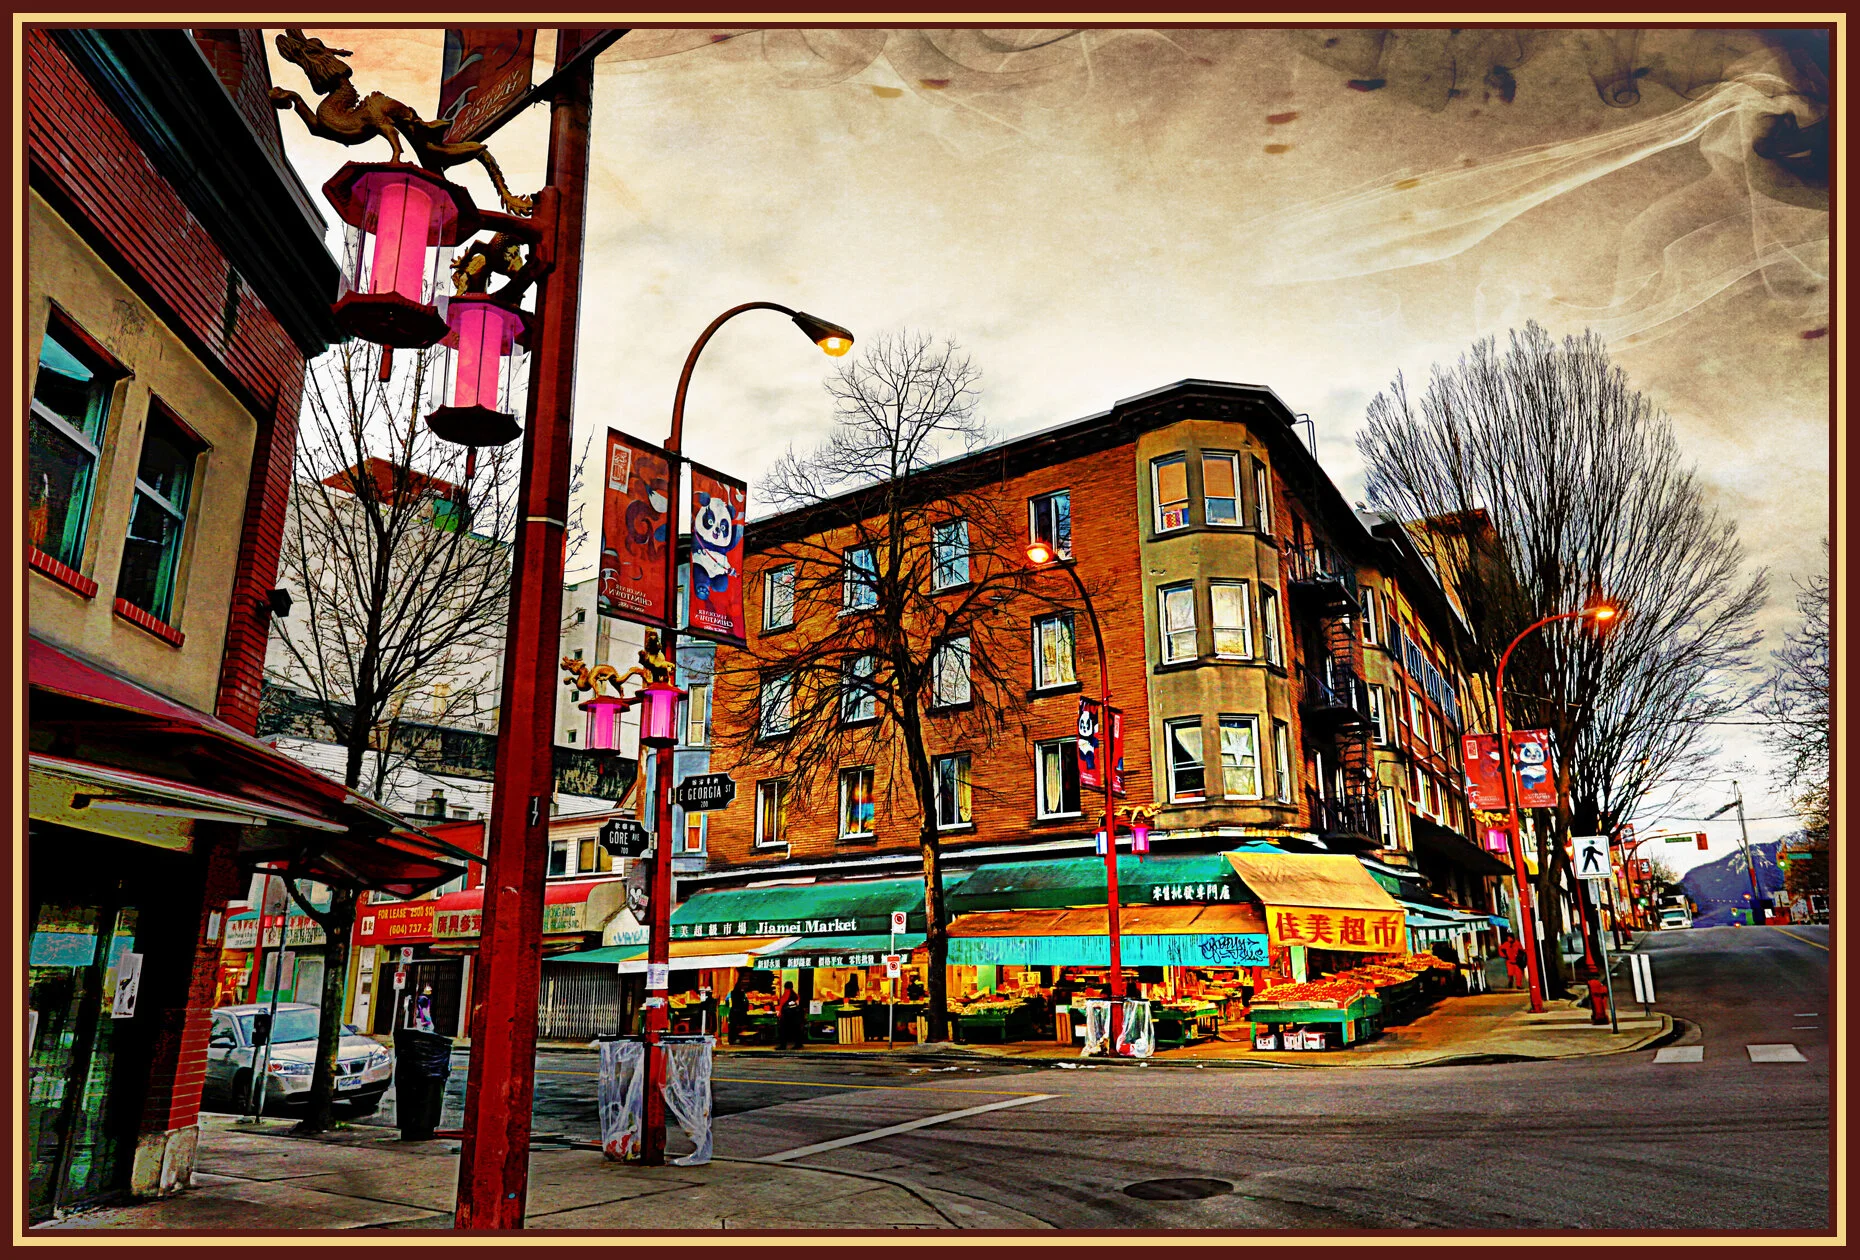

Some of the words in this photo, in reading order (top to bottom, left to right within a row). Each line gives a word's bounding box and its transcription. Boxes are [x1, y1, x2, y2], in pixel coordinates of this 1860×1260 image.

[679, 788, 684, 802] E
[687, 785, 722, 801] GEORGIA
[725, 784, 732, 793] ST
[700, 800, 709, 808] 200
[609, 830, 629, 845] GORE
[631, 833, 640, 842] AVE
[620, 847, 629, 855] 700
[377, 908, 389, 920] FOR
[389, 908, 407, 919] LEASE
[389, 924, 407, 937] (604)
[409, 923, 422, 933] 737
[755, 921, 801, 935] Jiamei
[804, 918, 857, 933] Market
[1274, 911, 1399, 948] 佳美超市
